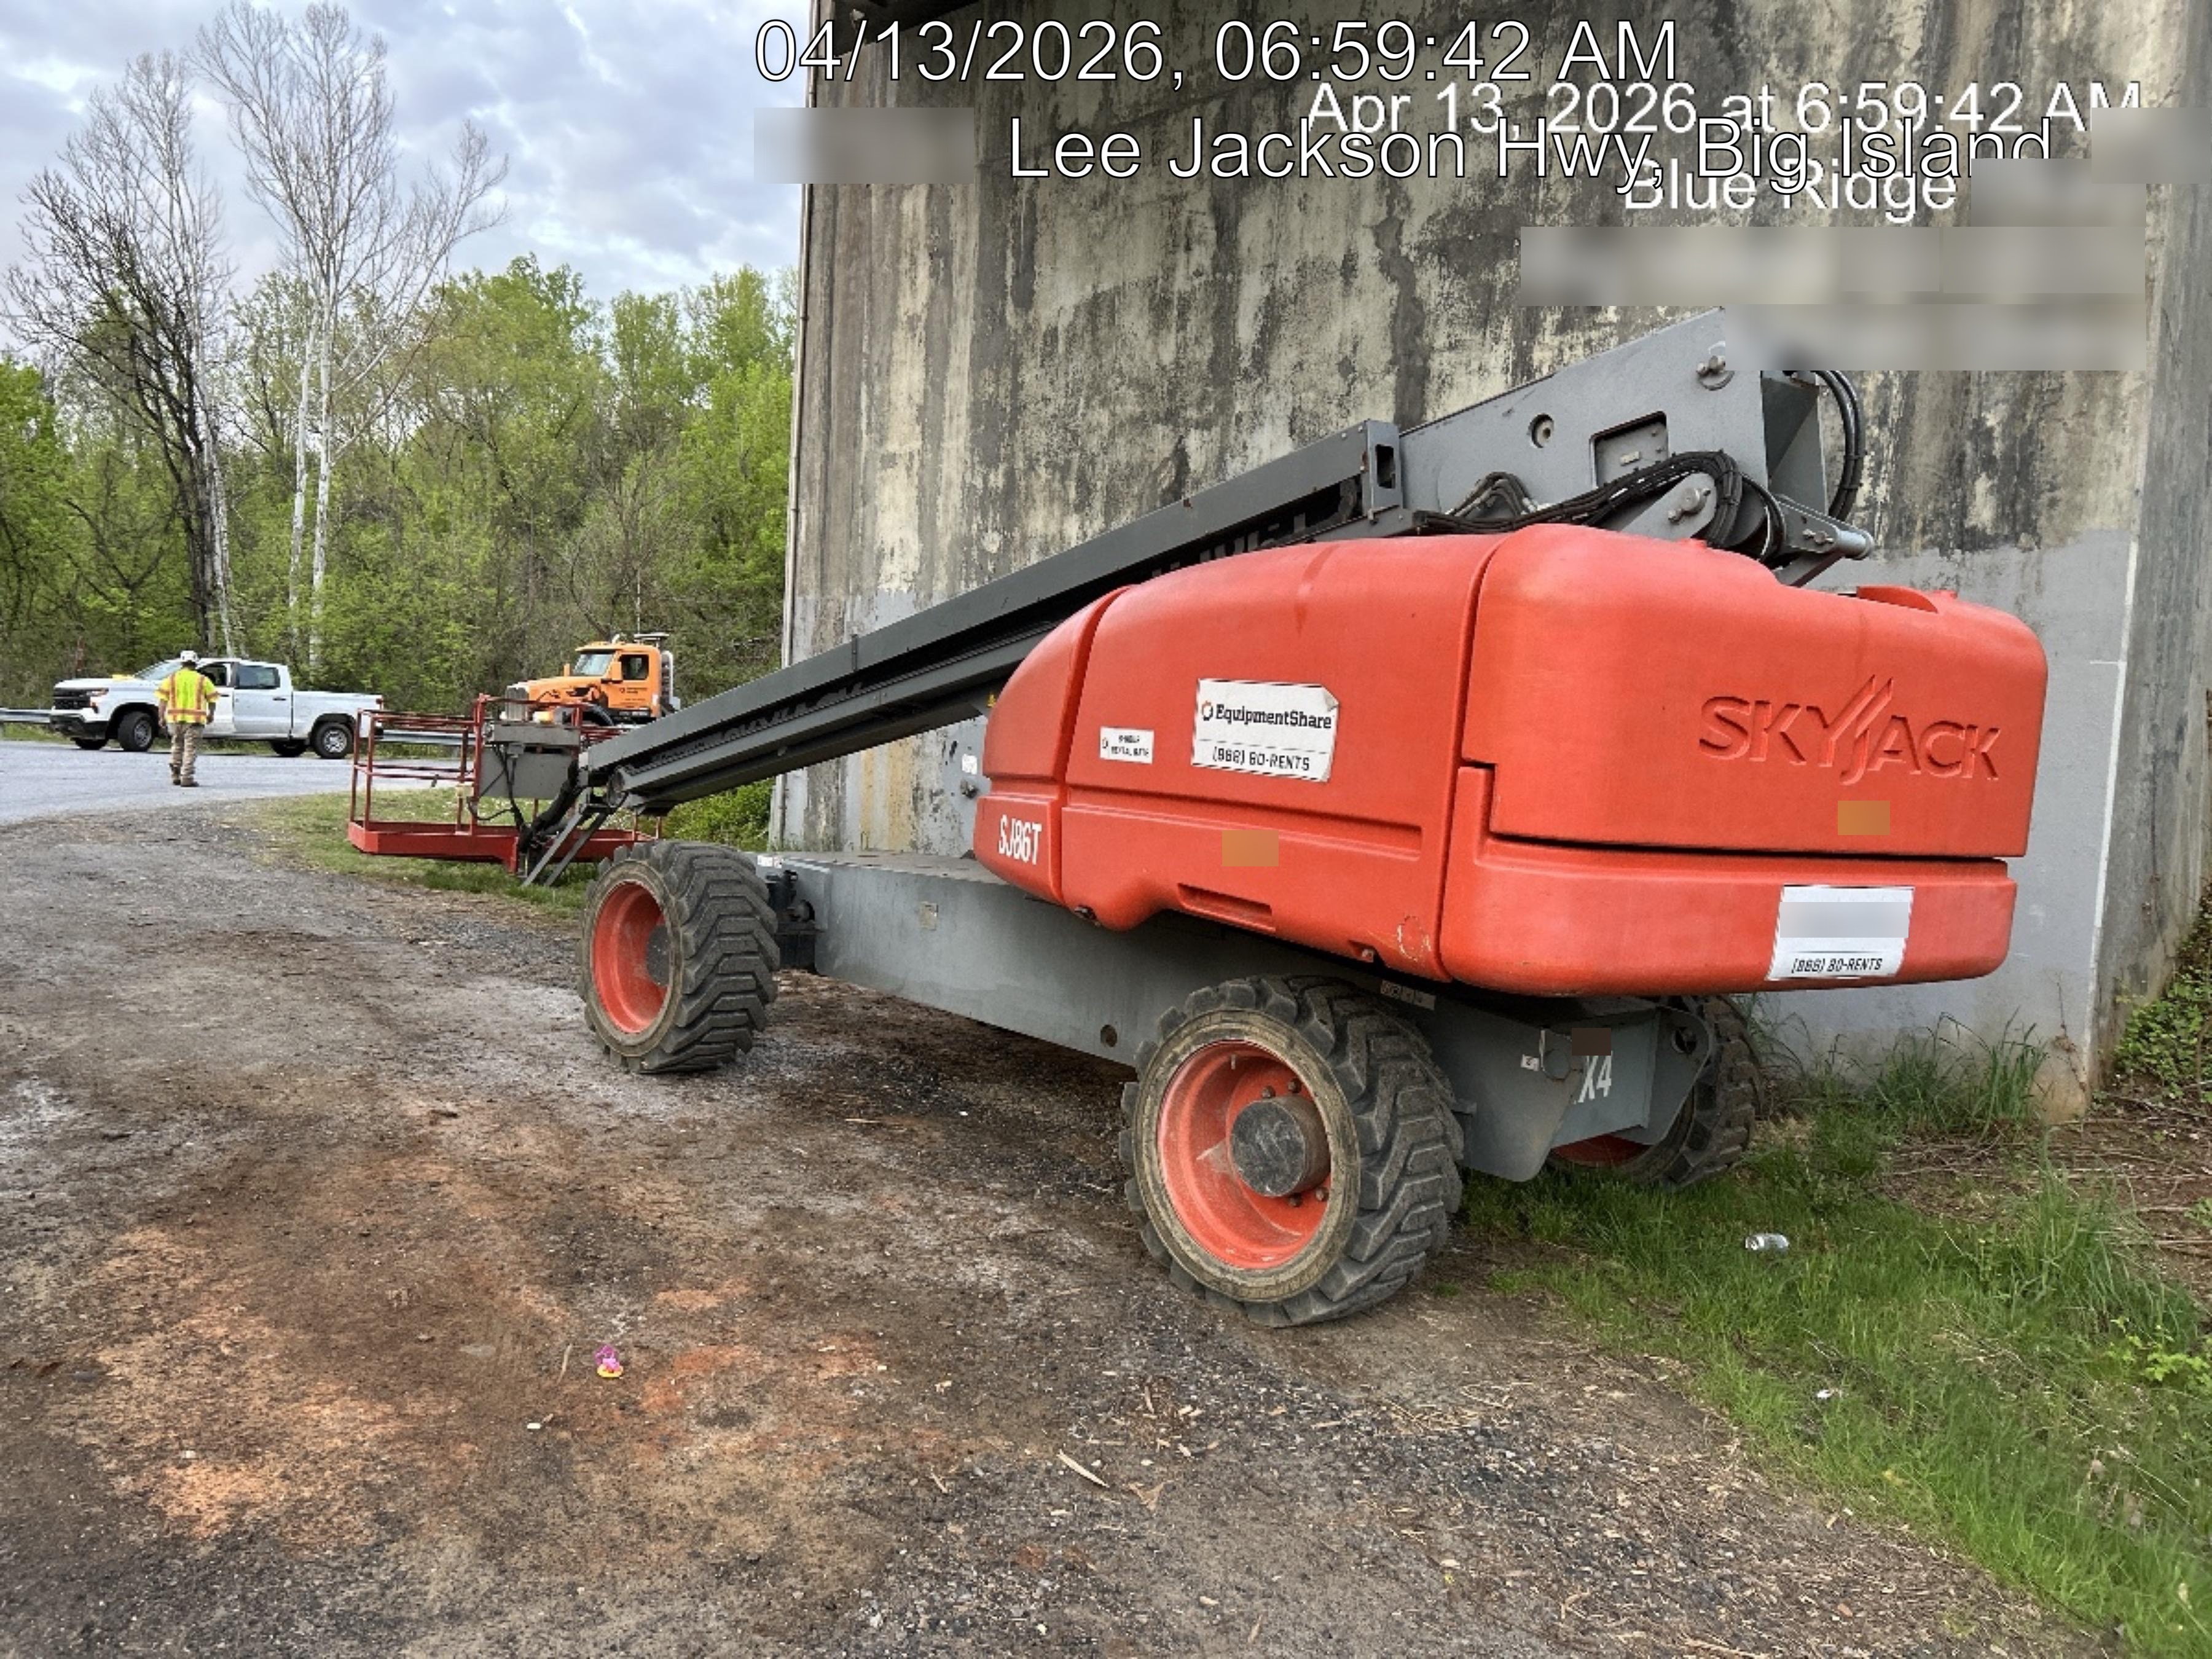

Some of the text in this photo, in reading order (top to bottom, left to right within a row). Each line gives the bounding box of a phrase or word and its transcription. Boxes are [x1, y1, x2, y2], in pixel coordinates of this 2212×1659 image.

[1215, 703, 1332, 729] EquipmentShare
[1700, 675, 2000, 785] SKYJACK
[998, 814, 1043, 866] SJ86T
